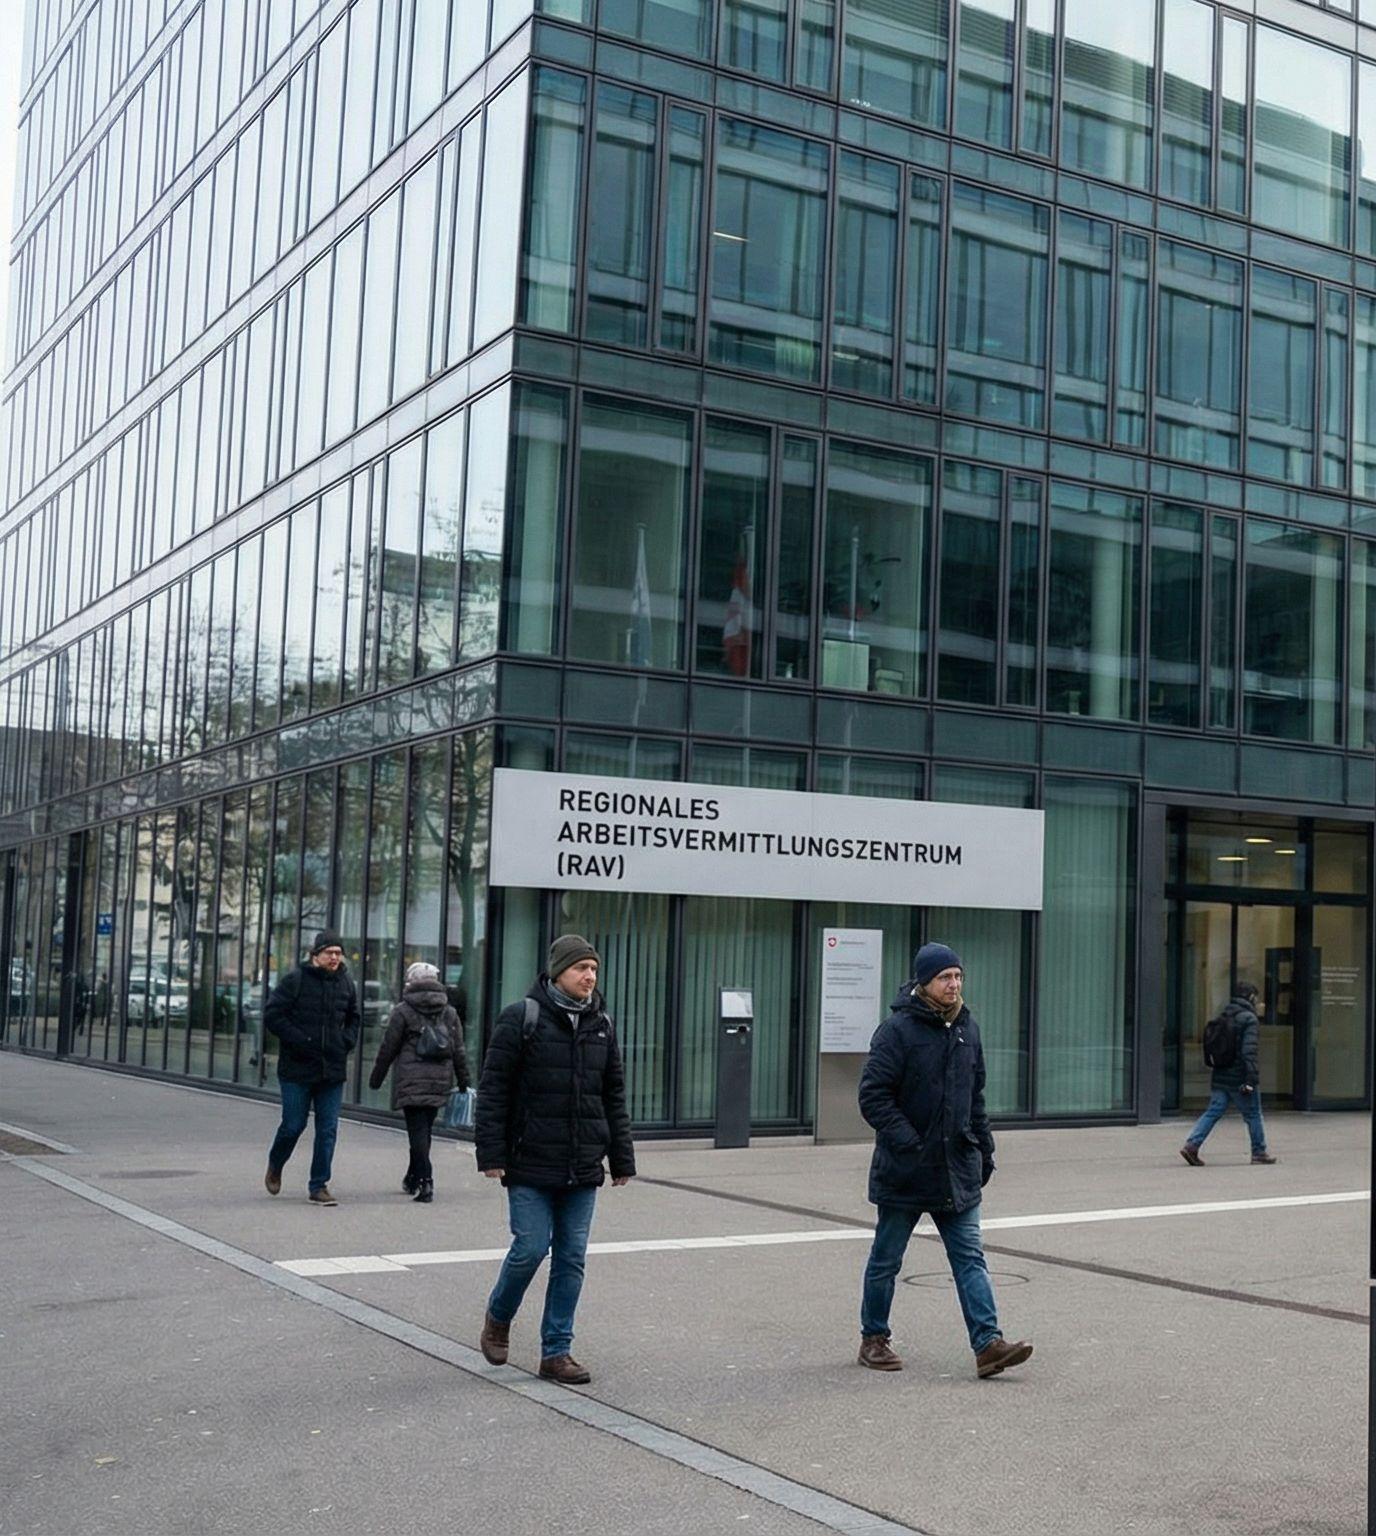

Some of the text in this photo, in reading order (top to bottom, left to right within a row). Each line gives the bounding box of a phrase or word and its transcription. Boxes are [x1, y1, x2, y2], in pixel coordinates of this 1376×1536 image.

[559, 788, 720, 820] REGIONALES
[557, 820, 962, 866] ARBEITSVERMITTLUNGSZENTRUM
[557, 851, 625, 880] (RAV)
